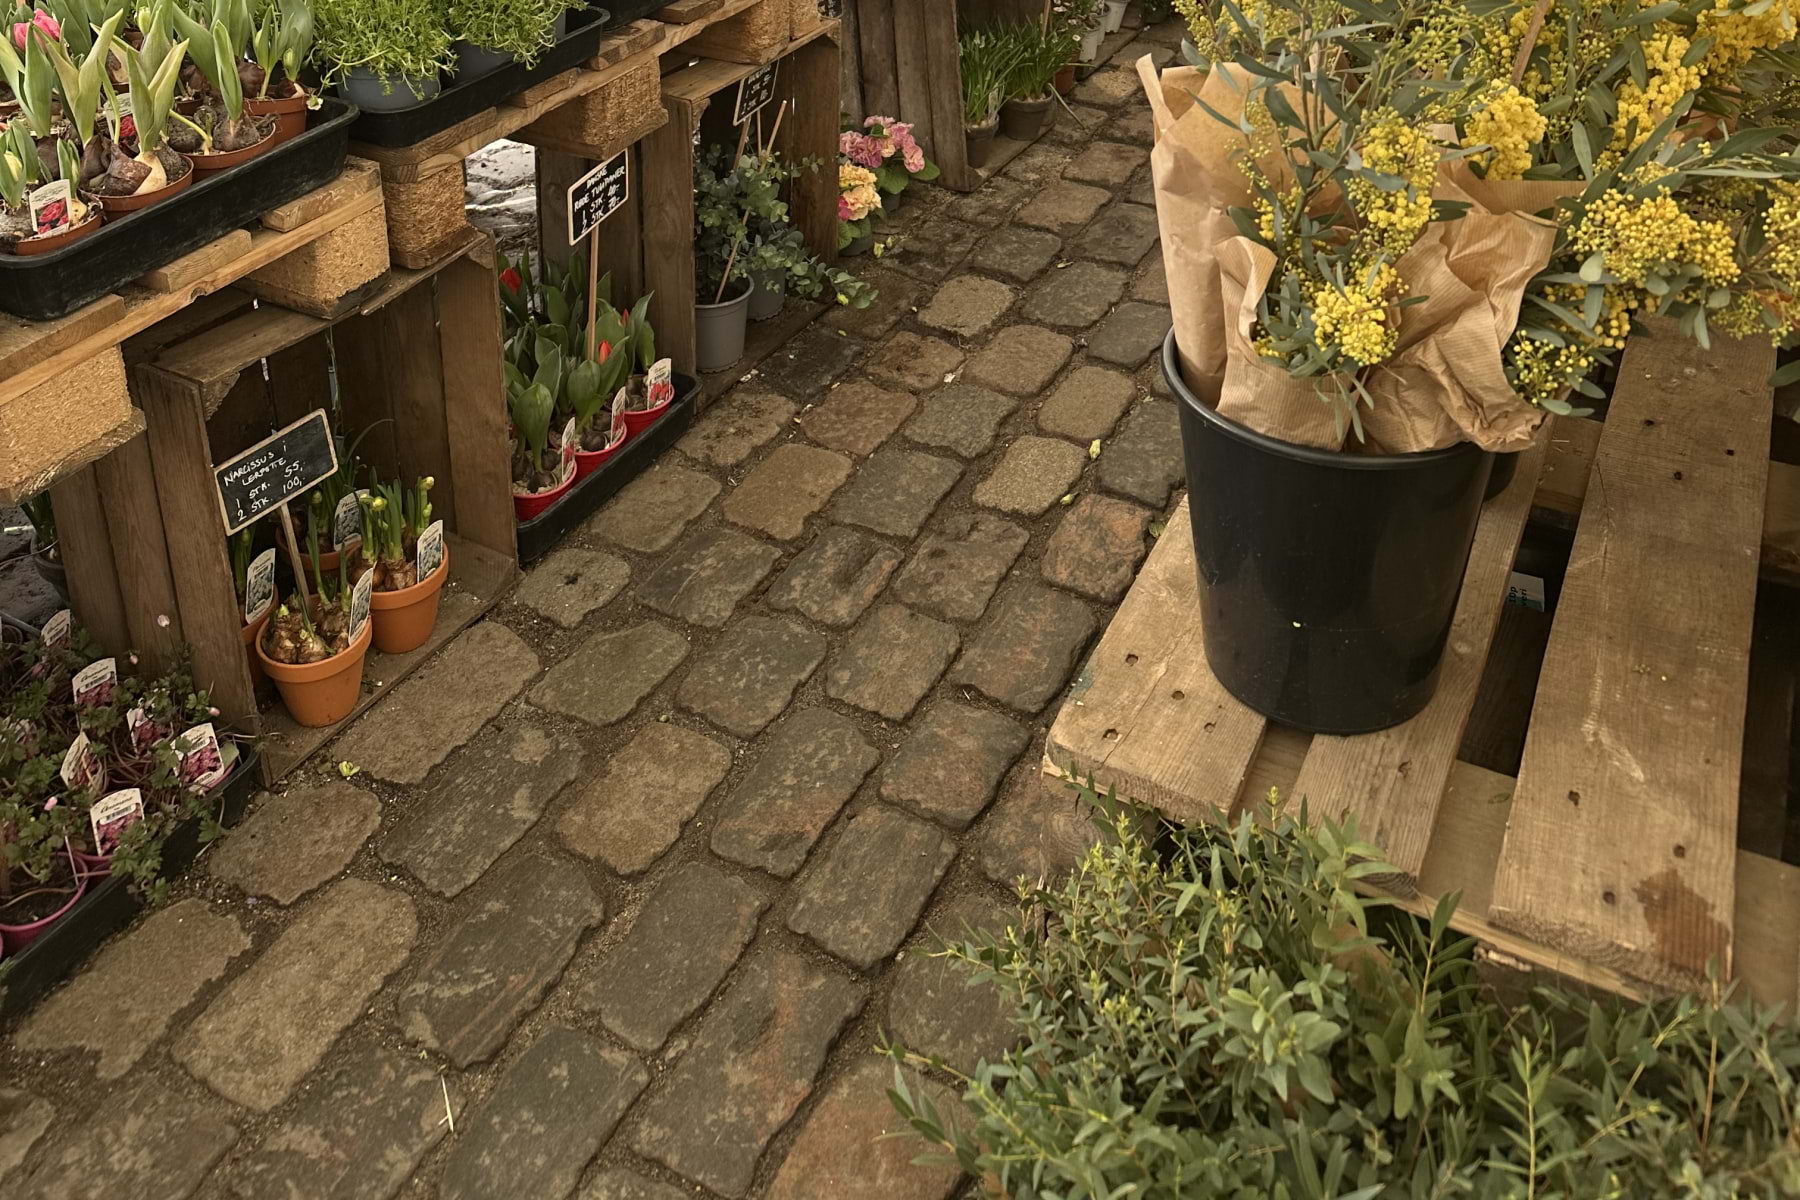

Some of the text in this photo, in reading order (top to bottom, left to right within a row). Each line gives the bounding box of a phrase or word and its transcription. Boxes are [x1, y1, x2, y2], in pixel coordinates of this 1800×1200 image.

[590, 193, 605, 213] STK
[590, 205, 605, 225] STK
[241, 457, 287, 486] LERPOTTE
[236, 498, 241, 509] 1
[237, 509, 248, 521] 2
